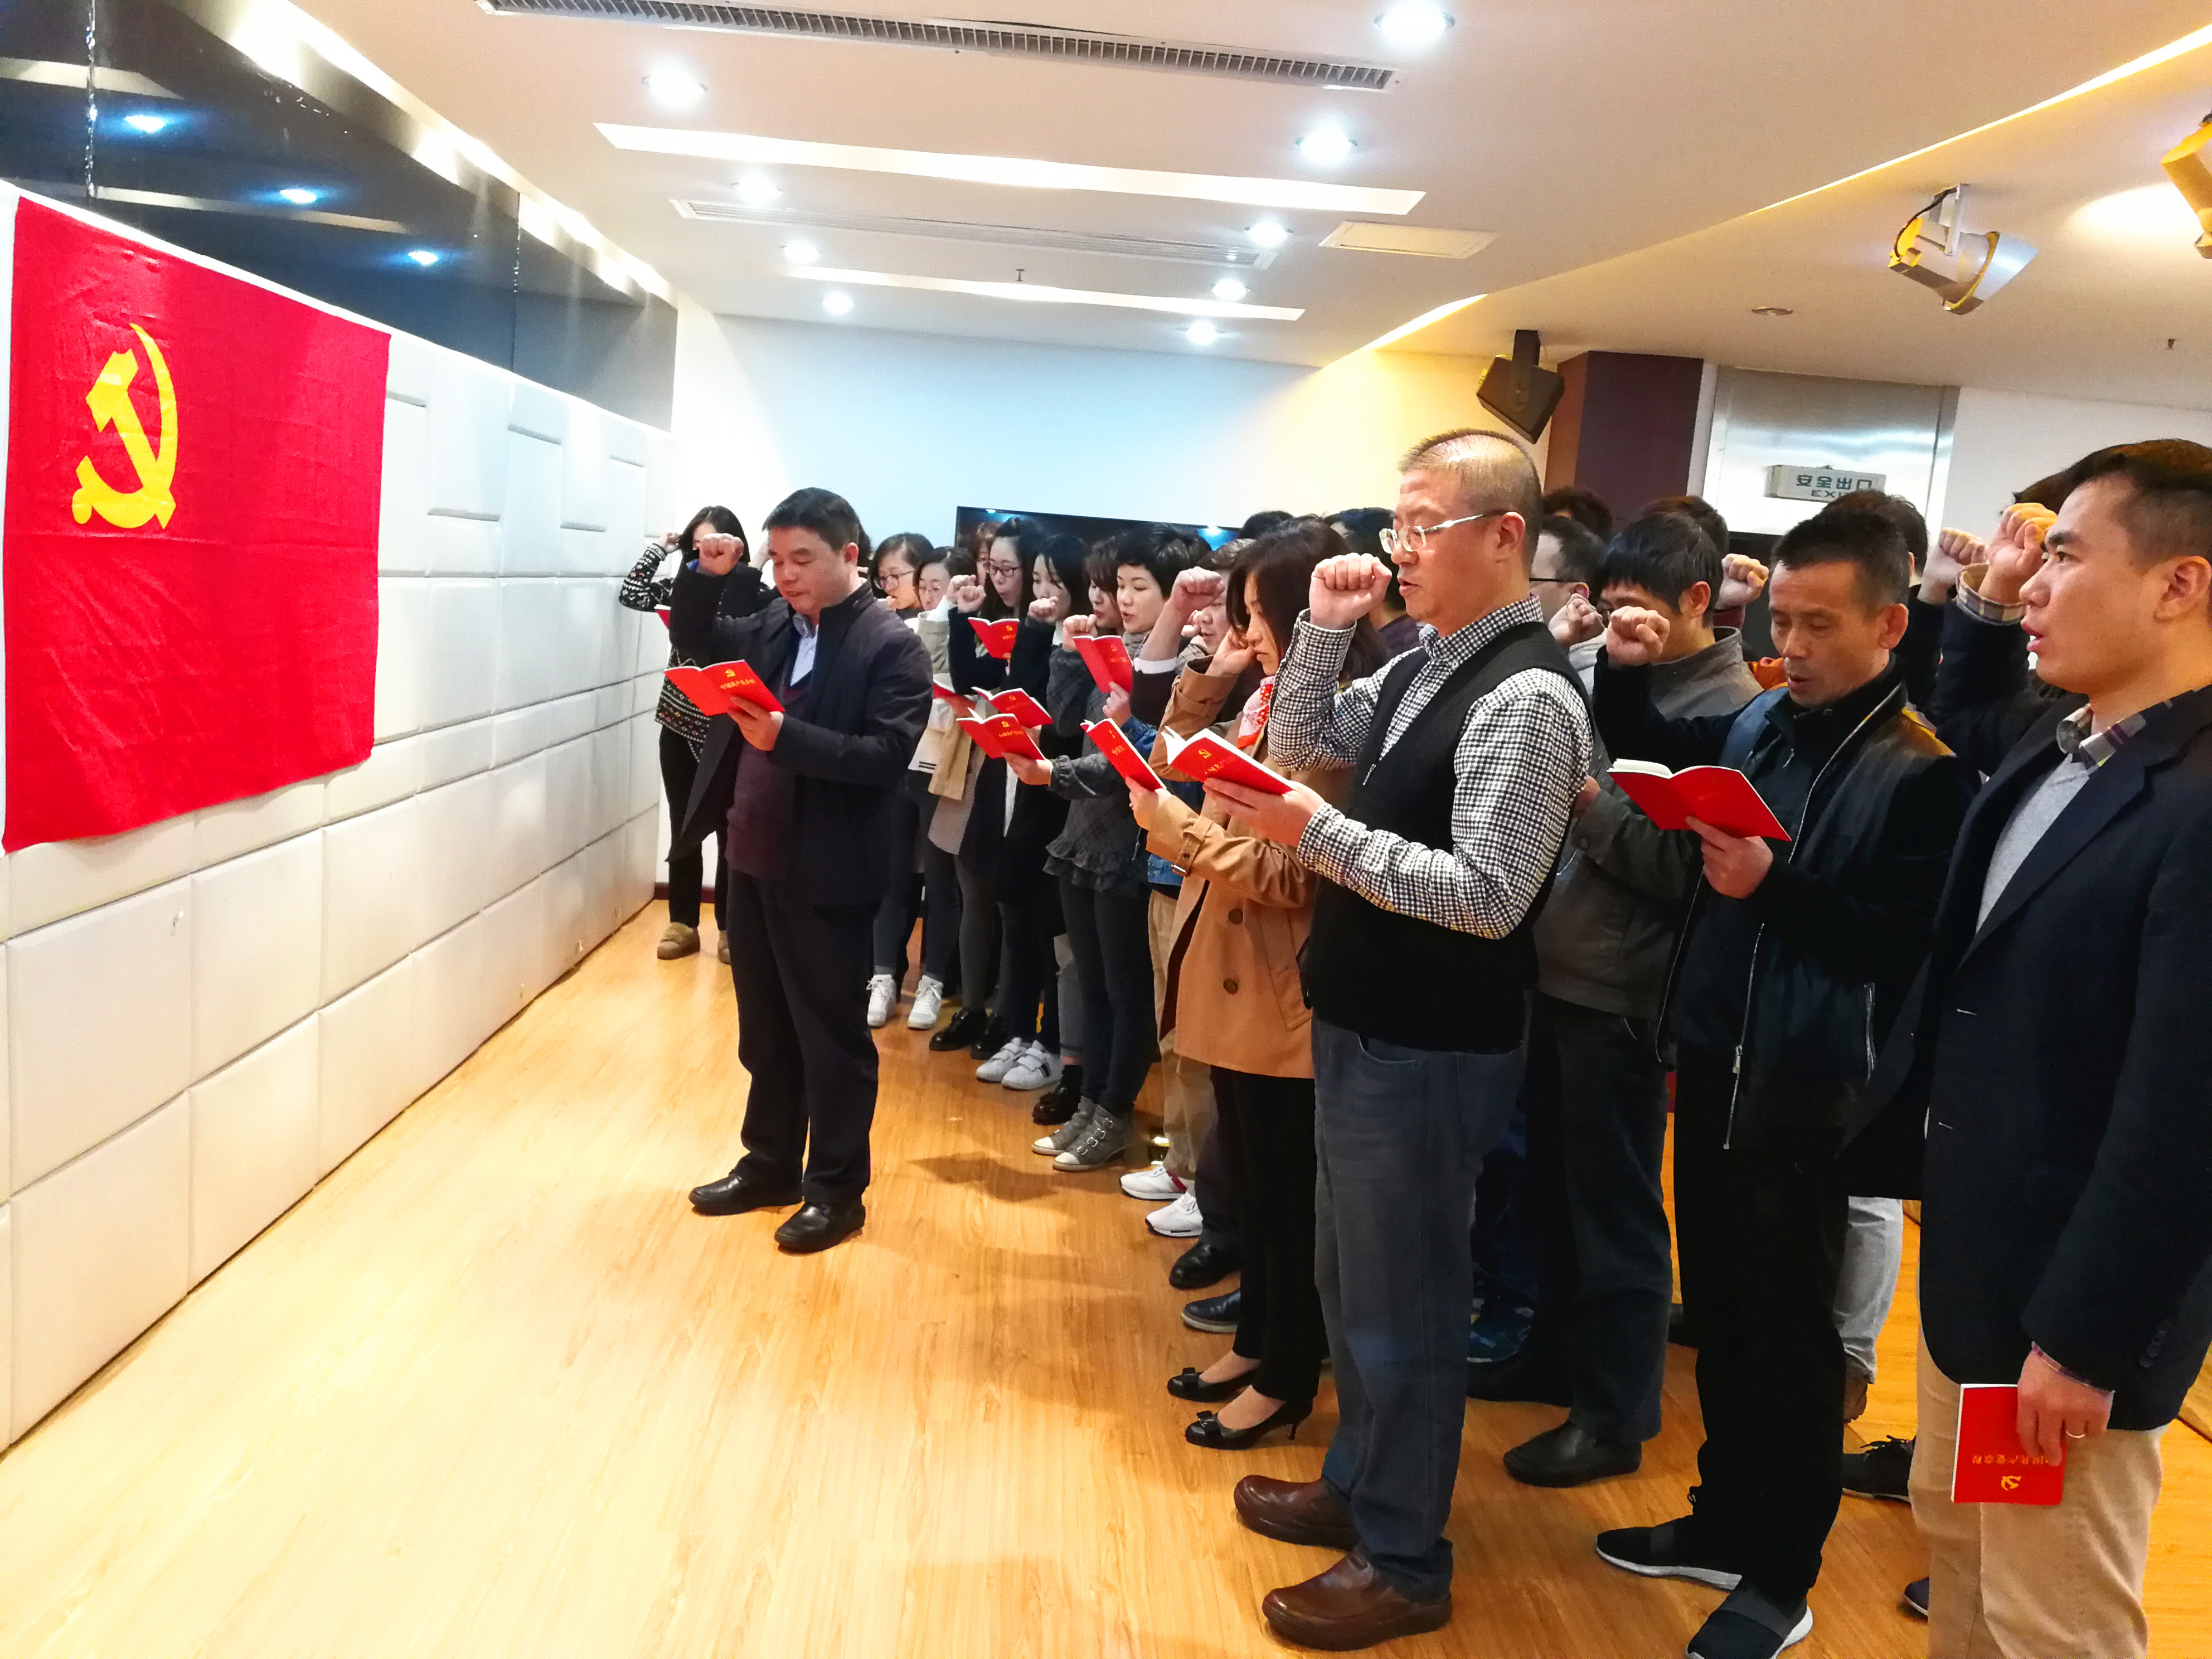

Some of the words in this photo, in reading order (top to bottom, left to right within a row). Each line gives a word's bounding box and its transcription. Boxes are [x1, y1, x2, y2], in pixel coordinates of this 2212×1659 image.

[1796, 474, 1872, 490] 安全出口
[1811, 489, 1847, 498] EXI
